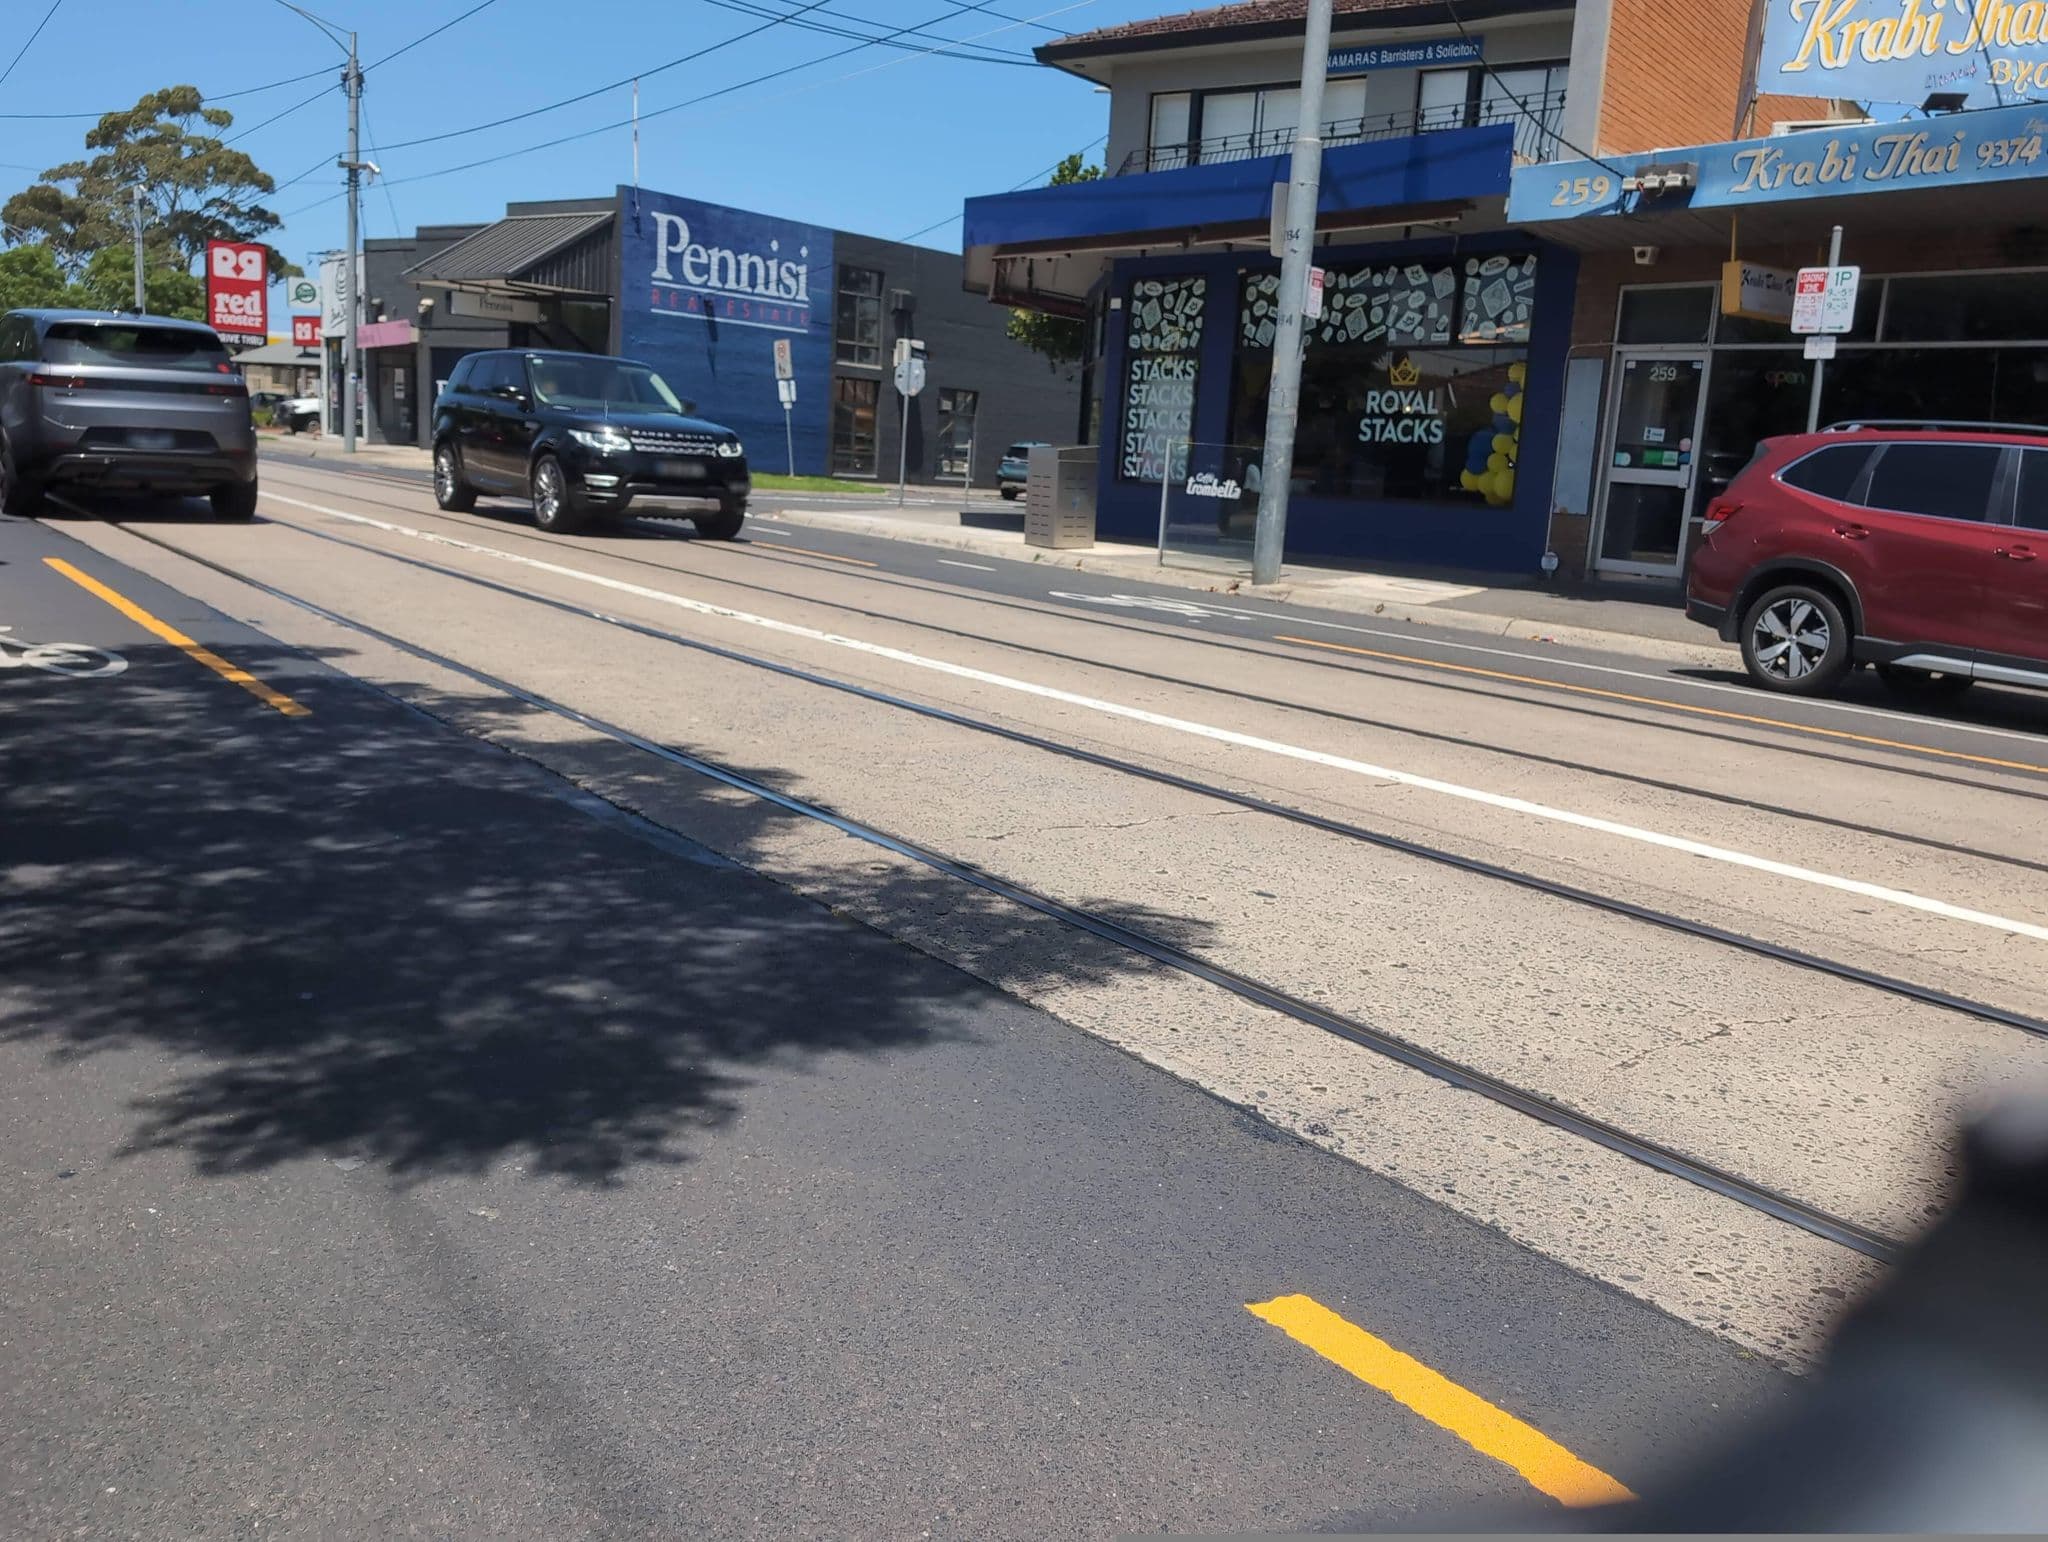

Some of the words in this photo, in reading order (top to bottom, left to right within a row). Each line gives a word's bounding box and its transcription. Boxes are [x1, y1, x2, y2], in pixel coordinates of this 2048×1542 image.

[1780, 0, 1945, 73] Krabi
[1381, 47, 1424, 64] Barristers
[1426, 46, 1434, 59] &
[1728, 139, 1862, 194] Krabi
[1862, 130, 1968, 183] Thai
[1976, 135, 2042, 170] 9374
[1550, 176, 1611, 206] 259
[651, 210, 810, 301] Pennisi
[1834, 271, 1853, 287] 1P
[214, 290, 263, 315] red
[727, 299, 808, 327] ESTATE
[214, 313, 263, 328] rooster
[218, 333, 240, 344] RIVE
[241, 335, 264, 346] THRU
[1131, 359, 1196, 382] STACKS
[1649, 366, 1677, 382] 259
[1129, 384, 1194, 406] STACKS
[1365, 389, 1439, 415] ROYAL
[1127, 408, 1191, 430] STACKS
[1358, 417, 1444, 445] STACKS
